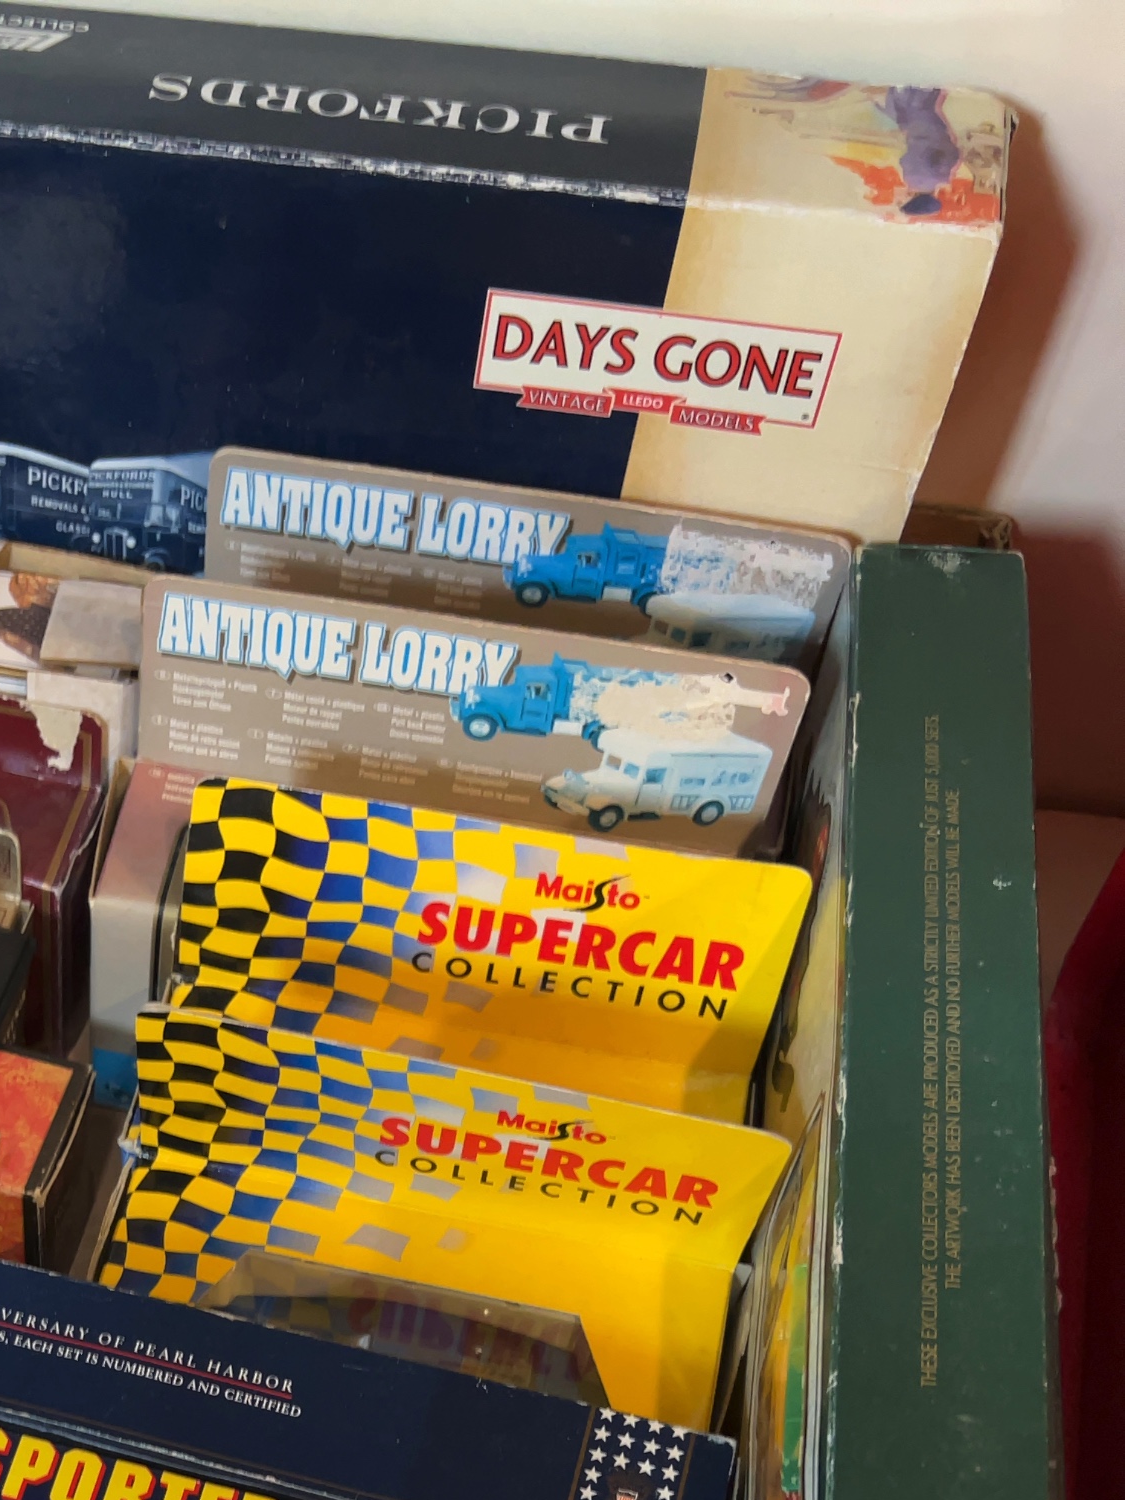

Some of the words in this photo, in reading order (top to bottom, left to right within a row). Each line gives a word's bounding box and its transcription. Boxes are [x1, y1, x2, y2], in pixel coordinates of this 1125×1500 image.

[148, 71, 613, 145] PICKFORDS
[492, 313, 639, 374] DAYS
[654, 335, 824, 399] GONE
[528, 390, 606, 413] VINTAGE
[622, 392, 664, 409] LLEDO
[678, 409, 754, 432] MODELS
[220, 465, 414, 550] ANTIQUE
[415, 491, 571, 567] LORRY
[157, 591, 356, 681] ANTIQUE
[358, 620, 519, 698] LORRY
[946, 843, 961, 869] WILL
[534, 872, 643, 911] Maisto
[946, 872, 961, 920] MODELS
[417, 902, 745, 991] SUPERCAR
[923, 920, 938, 972] STRICTLY
[946, 924, 961, 975] FURTHER
[411, 950, 729, 1021] COLLECTION
[923, 987, 938, 1006] AS
[946, 977, 961, 1000] NO
[923, 1009, 938, 1079] PRODUCED
[946, 1003, 961, 1034] AND
[923, 1083, 938, 1109] ARE
[945, 1037, 961, 1113] DESTROYED
[496, 1108, 608, 1146] Maisto
[923, 1112, 938, 1168] MODELS
[945, 1116, 961, 1152] BEEN
[374, 1148, 705, 1225] COLLECTION
[379, 1116, 719, 1208] SUPERCAR
[945, 1155, 961, 1184] HAS
[921, 1172, 937, 1260] COLLECTORS
[945, 1189, 961, 1260] ARTWORK
[921, 1264, 937, 1339] EXCLUSIVE
[945, 1263, 961, 1289] THE
[13, 1335, 54, 1355] EACH
[56, 1345, 83, 1364] SET
[85, 1351, 98, 1366] IS
[101, 1355, 184, 1387] NUMBERED
[187, 1377, 220, 1397] AND
[224, 1387, 302, 1418] CERTIFIED
[98, 1331, 126, 1349] OF
[134, 1340, 197, 1369] PEARL
[206, 1359, 294, 1394] HARBOR
[921, 1343, 937, 1387] THESE
